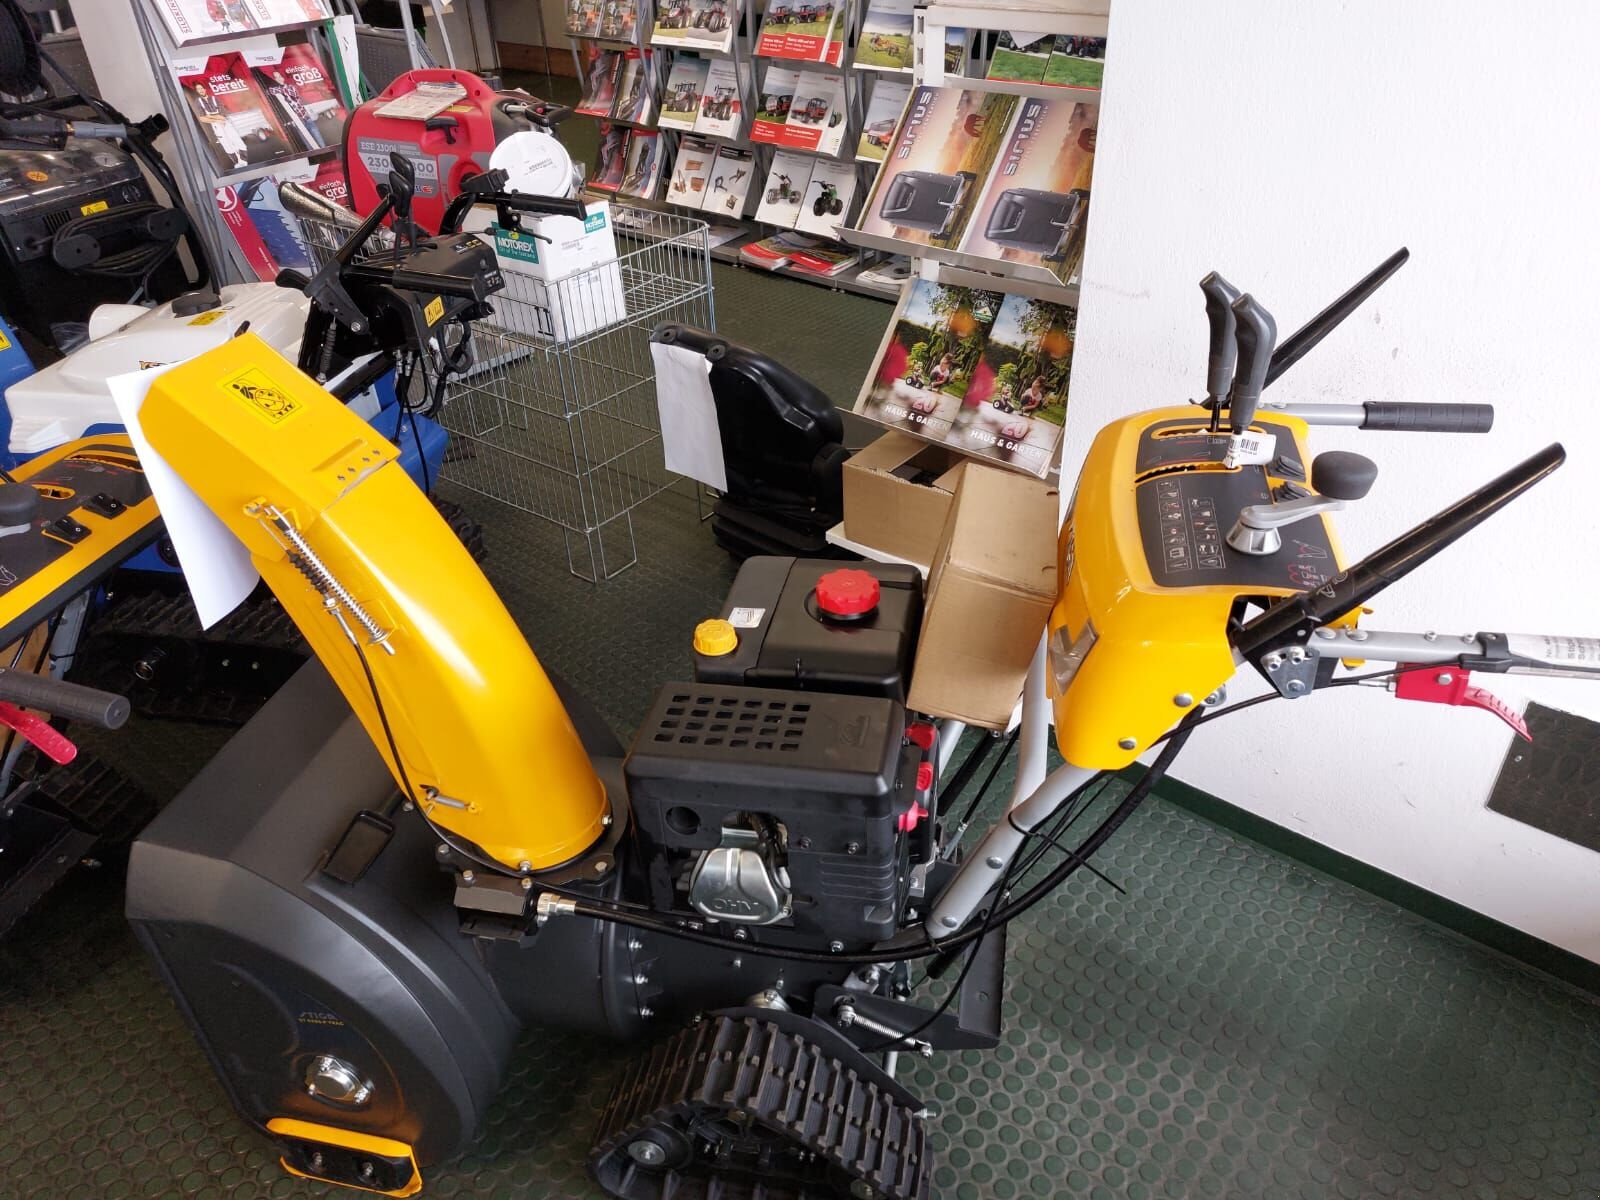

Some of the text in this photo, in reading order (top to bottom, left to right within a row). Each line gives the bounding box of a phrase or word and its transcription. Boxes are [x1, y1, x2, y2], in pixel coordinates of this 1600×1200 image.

[285, 64, 311, 74] einfach
[292, 67, 322, 86] groß
[209, 78, 247, 93] bereit
[210, 74, 231, 83] stets
[360, 142, 375, 151] ESE
[376, 144, 397, 153] 2300i
[318, 180, 342, 191] einfach
[497, 236, 534, 253] MOTOREX
[885, 405, 950, 431] HAUS & GARTEN
[969, 429, 1043, 459] HAUS & GARTEN
